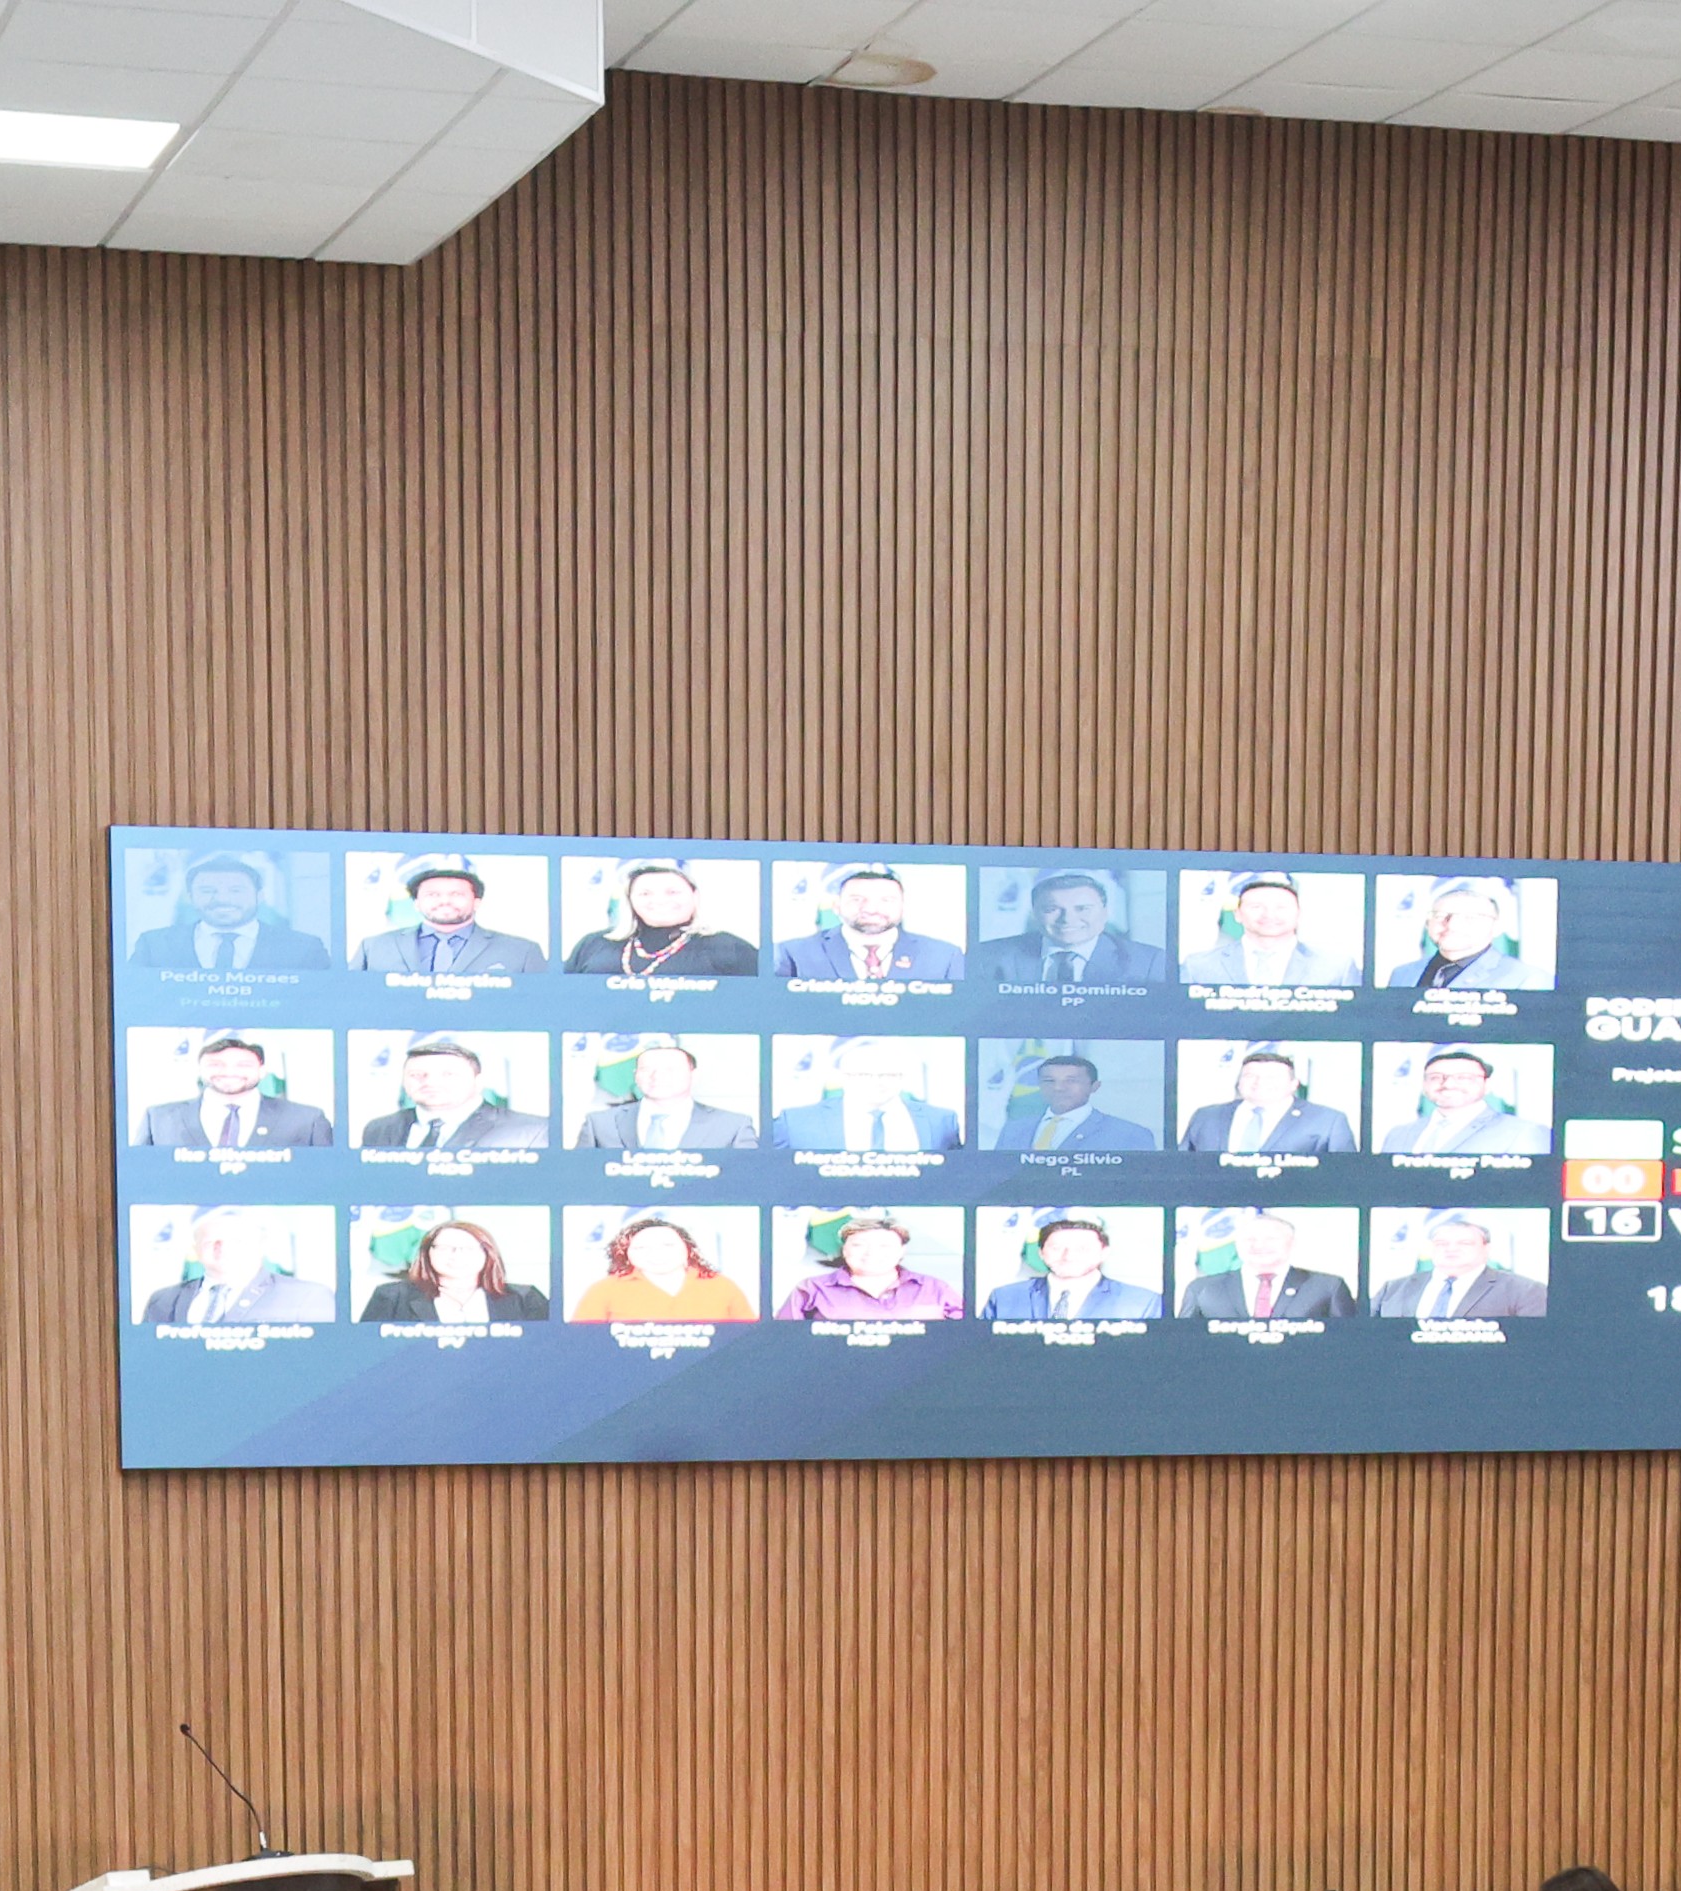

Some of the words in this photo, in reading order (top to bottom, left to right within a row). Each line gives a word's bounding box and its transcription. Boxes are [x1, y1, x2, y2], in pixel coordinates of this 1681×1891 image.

[160, 970, 213, 985] Pedro
[215, 972, 300, 985] Moraes
[606, 976, 646, 991] Cris
[207, 985, 252, 996] MDB
[908, 980, 953, 995] Cruz
[998, 982, 1058, 996] Danilo
[1060, 983, 1148, 997] Dominico
[1188, 984, 1216, 999] Dr.
[180, 997, 282, 1009] Presidente
[841, 993, 899, 1006] NOVO
[1061, 996, 1086, 1007] PP
[1021, 1153, 1070, 1168] Nego
[1072, 1153, 1123, 1166] Silvio
[818, 1164, 920, 1178] CIDADANIA
[1061, 1166, 1082, 1177] PL
[1581, 1165, 1645, 1194] 00
[1584, 1206, 1643, 1236] 16
[205, 1337, 266, 1351] NOVO
